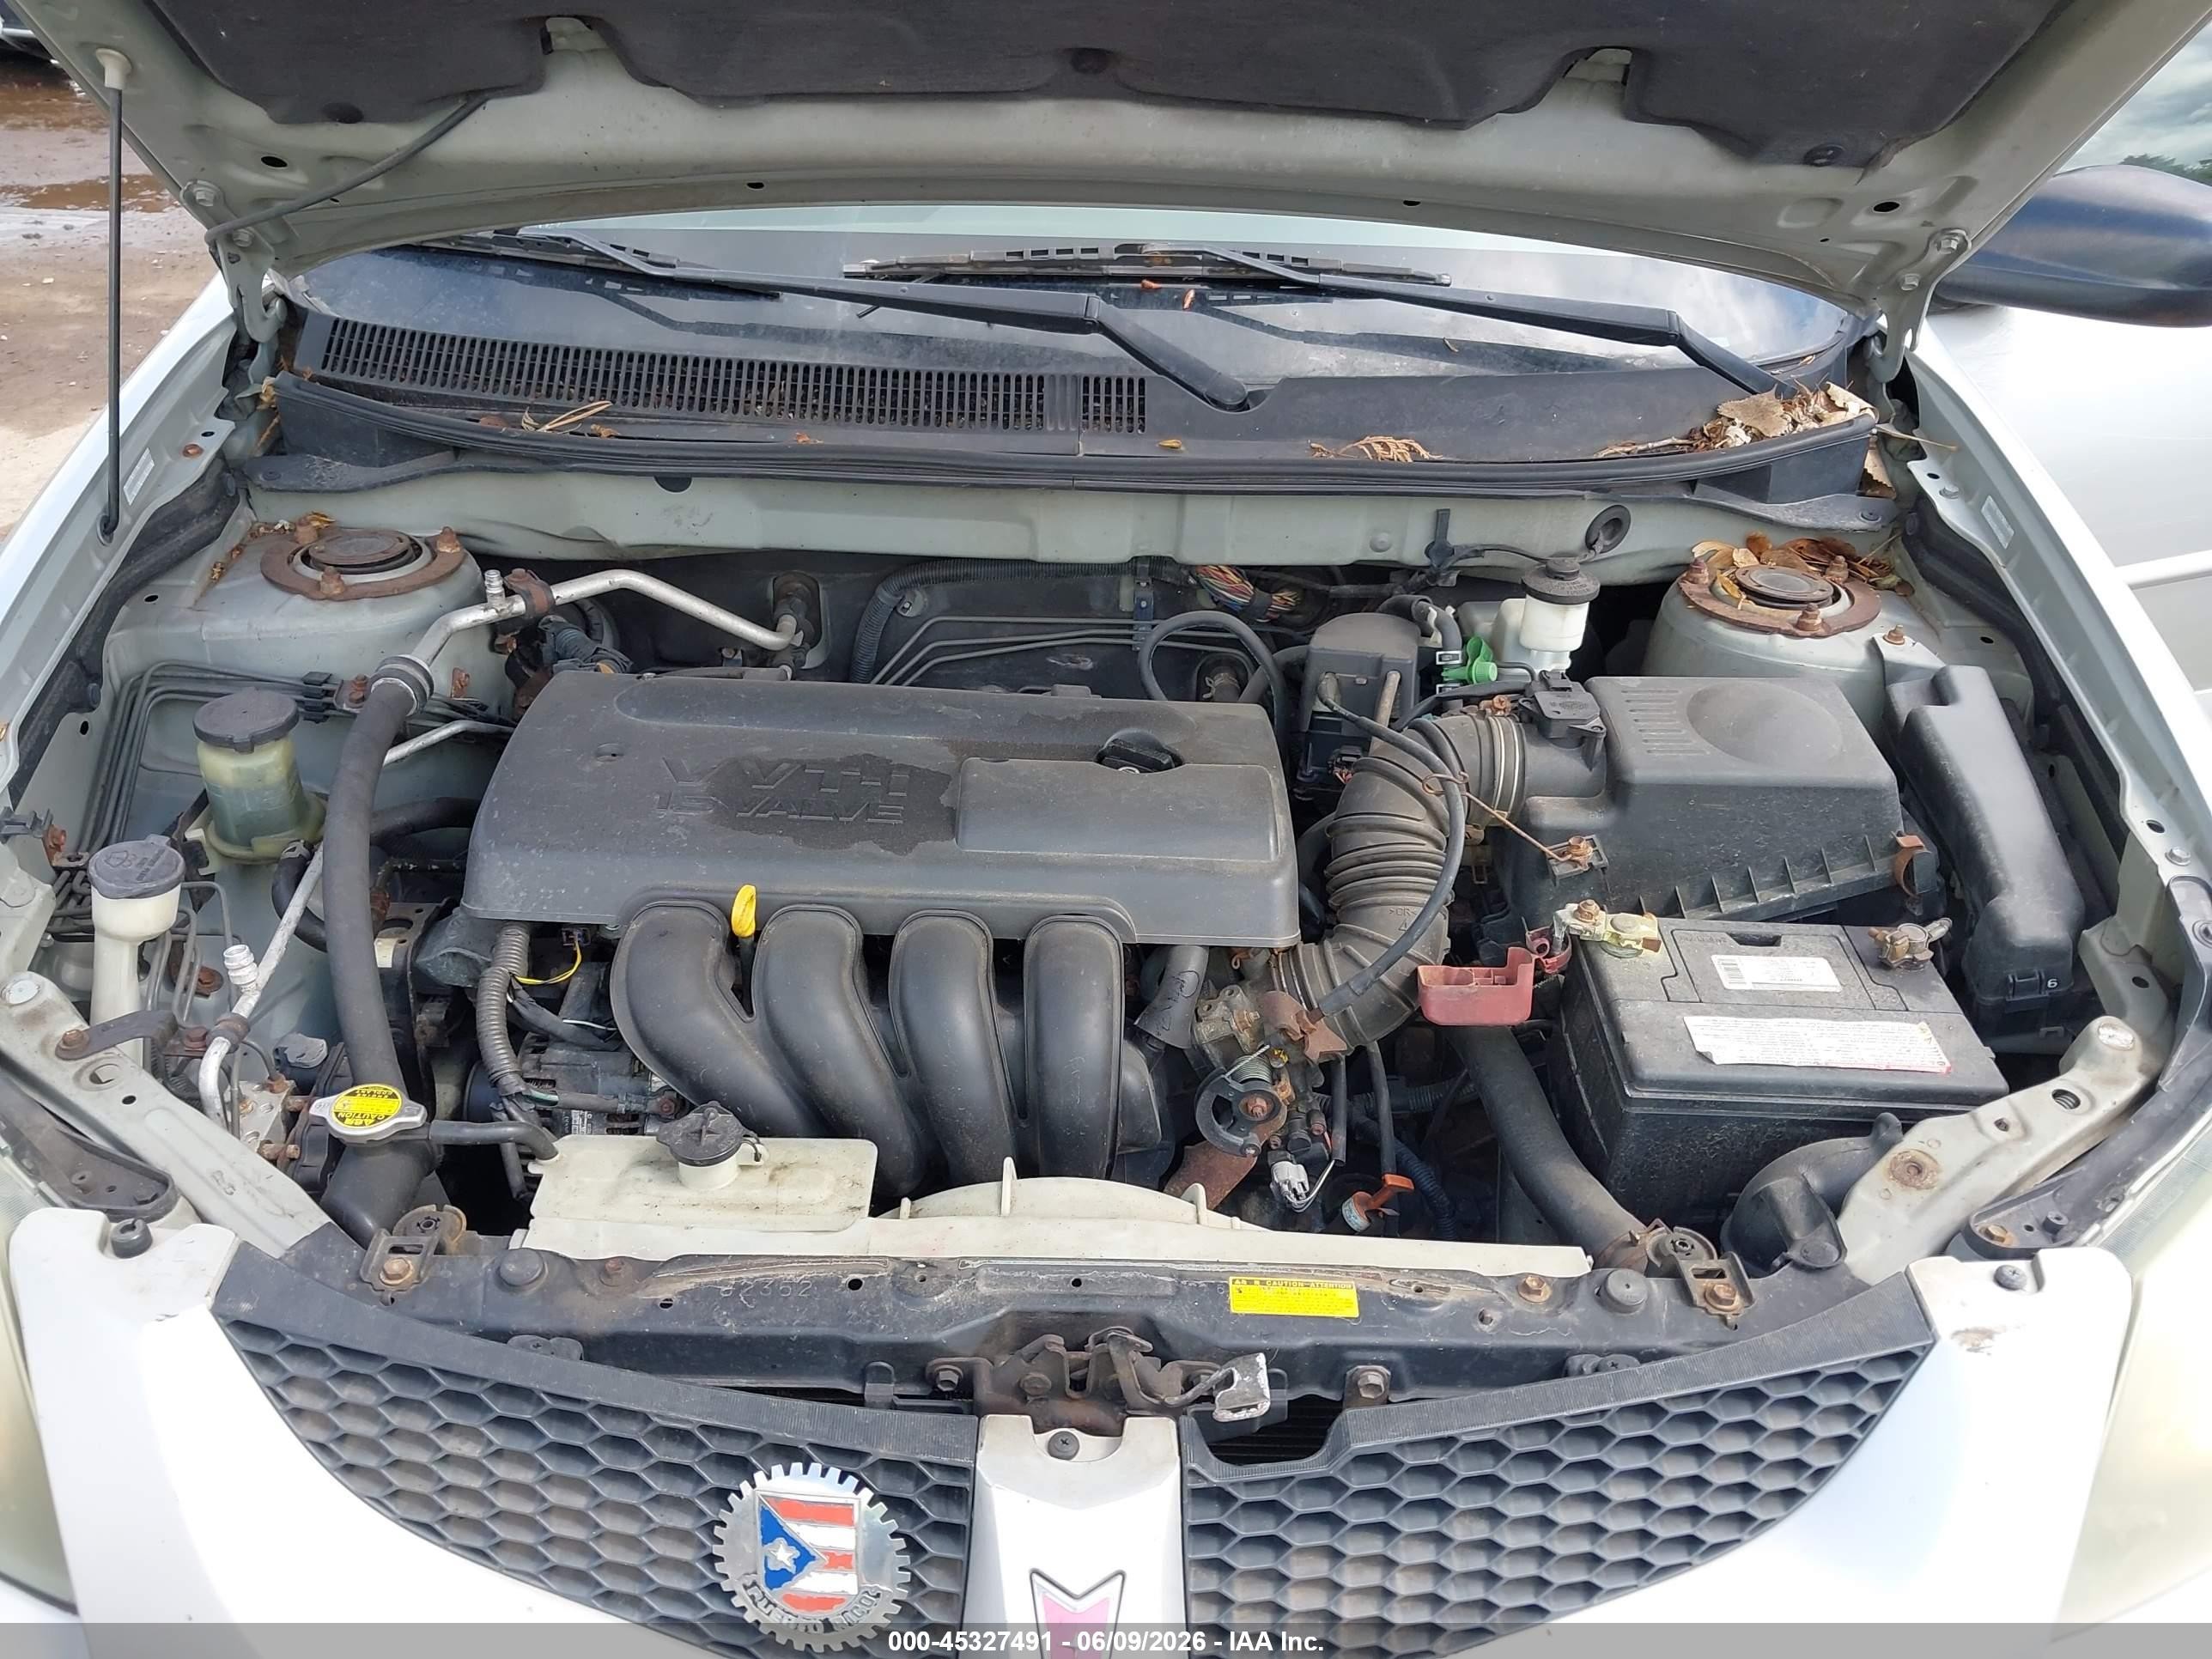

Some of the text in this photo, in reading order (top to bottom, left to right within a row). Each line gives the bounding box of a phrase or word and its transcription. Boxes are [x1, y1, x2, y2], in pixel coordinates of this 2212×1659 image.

[337, 1111, 386, 1121] CAUTION
[746, 1585, 878, 1634] PUERTO RICO
